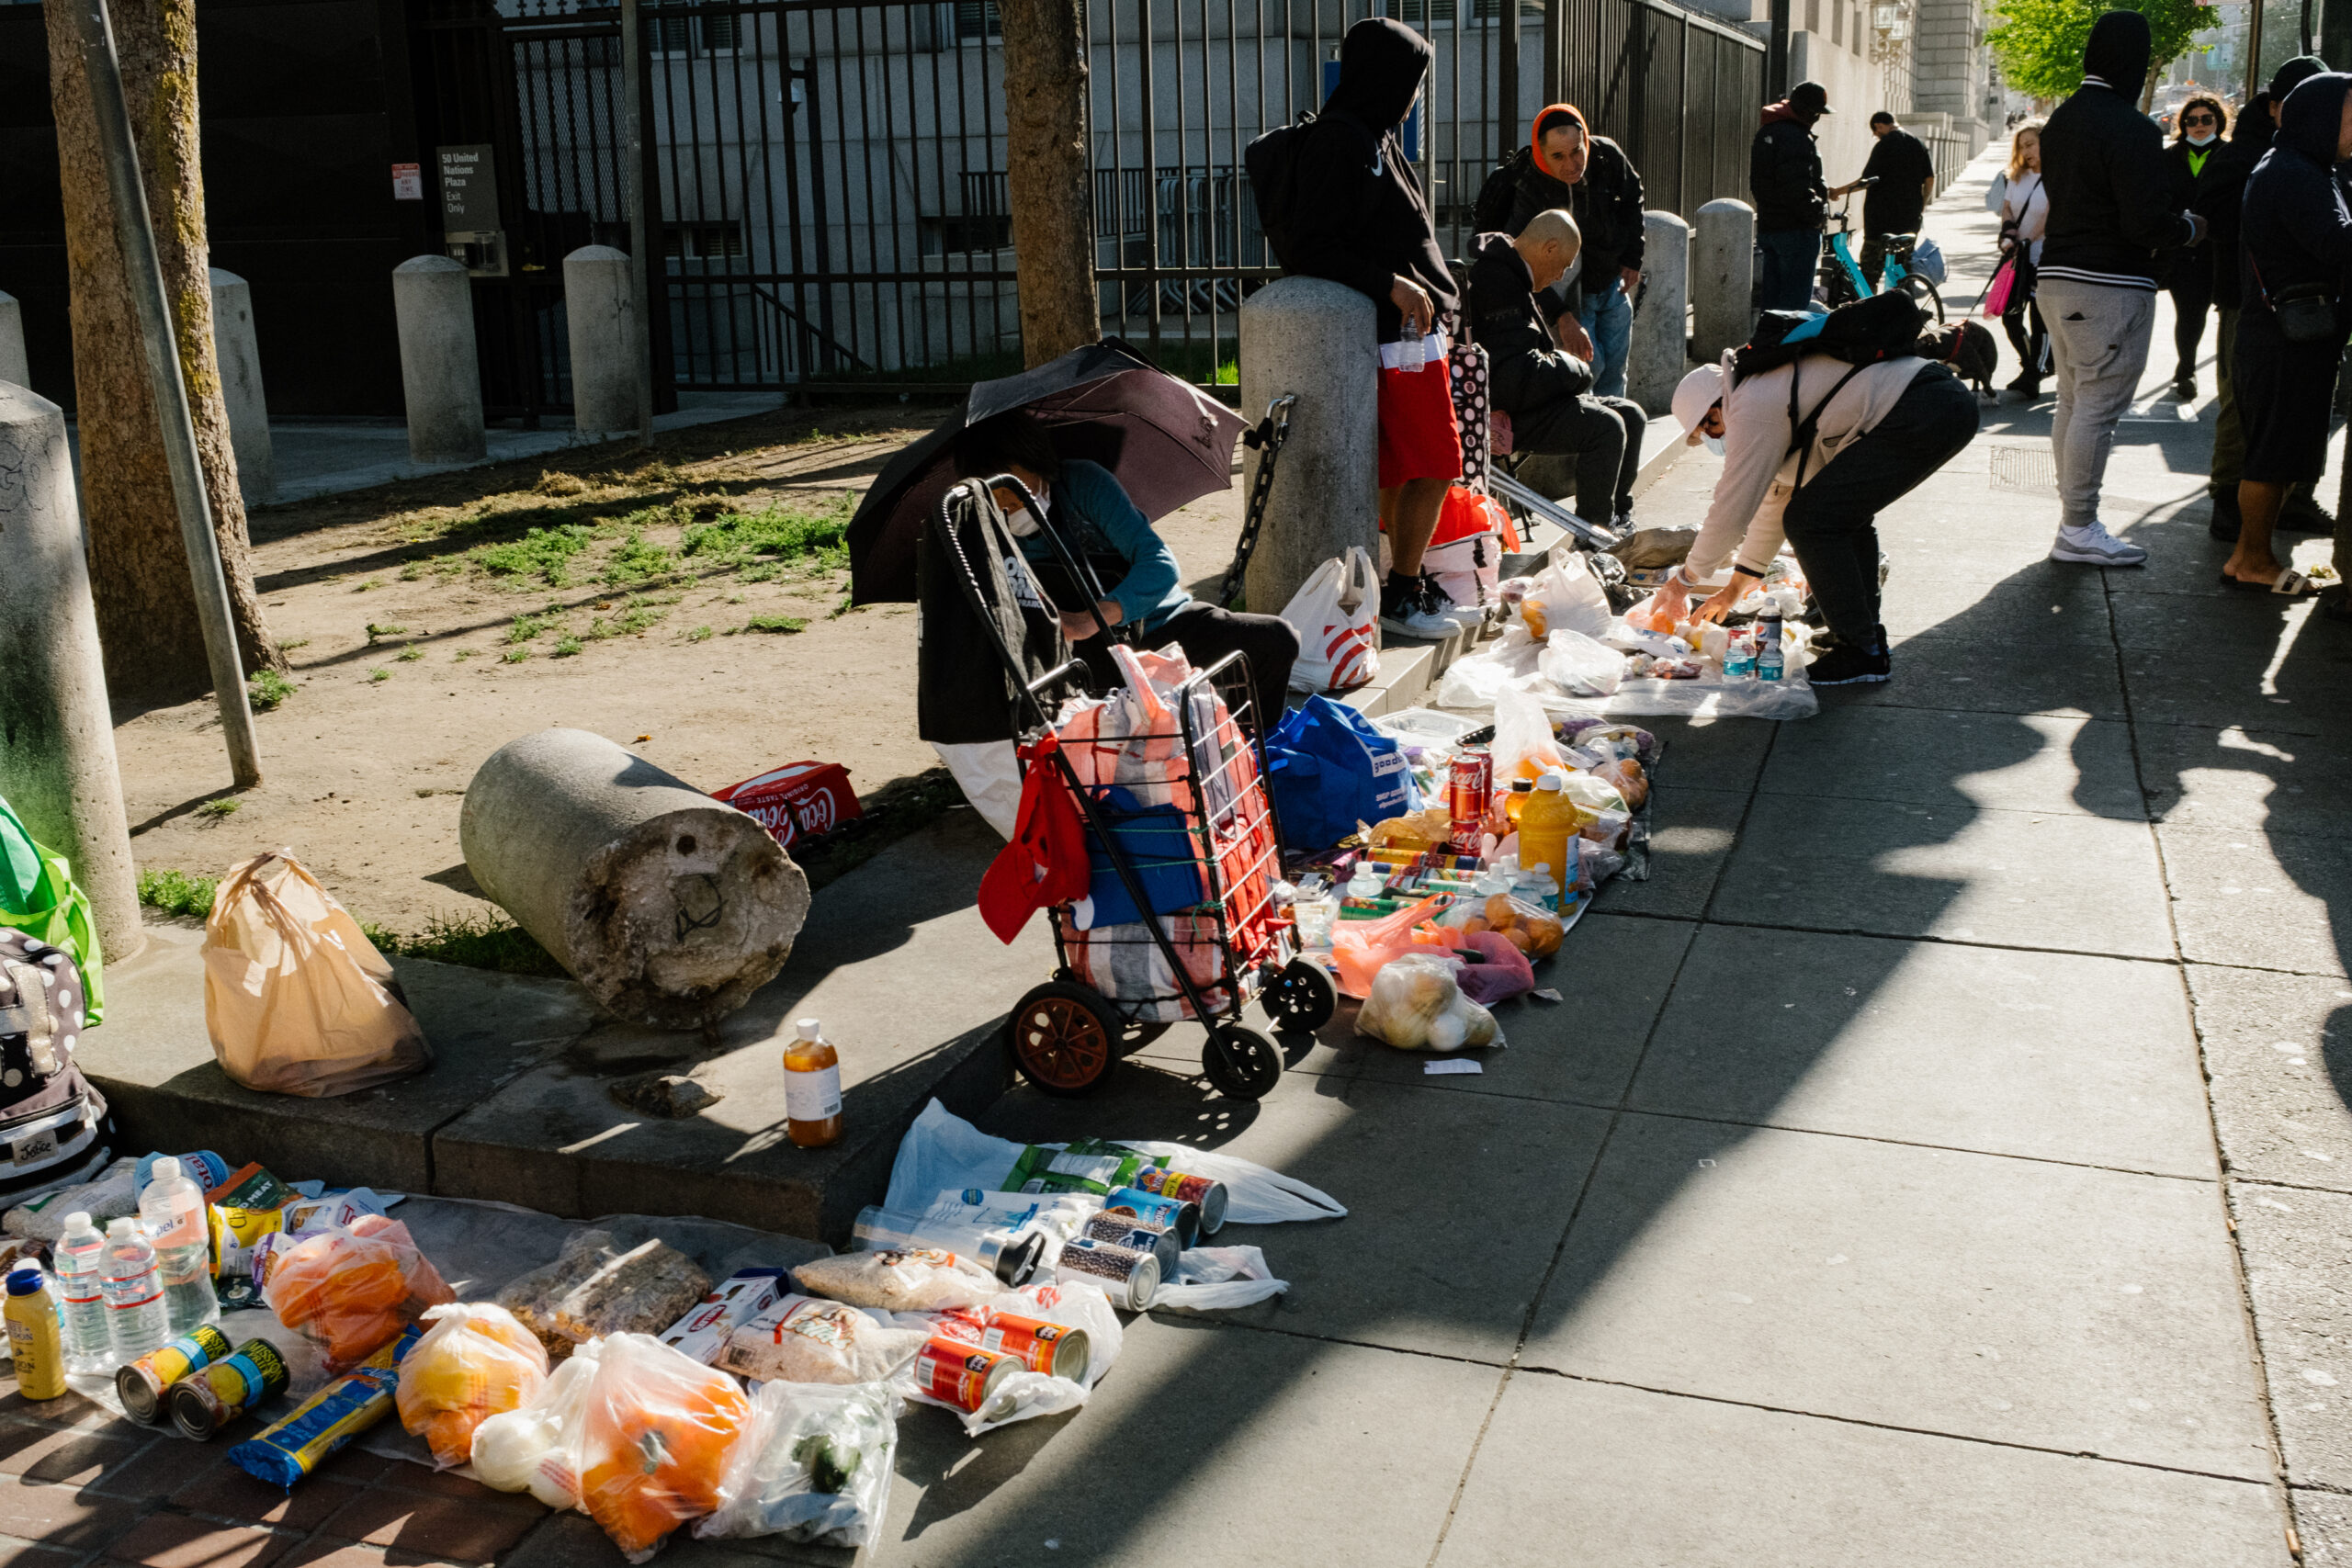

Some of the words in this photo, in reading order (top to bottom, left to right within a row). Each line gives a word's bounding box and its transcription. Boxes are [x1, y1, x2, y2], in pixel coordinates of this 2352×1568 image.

[442, 153, 451, 164] 50
[453, 152, 479, 163] United
[444, 165, 474, 175] Nations
[445, 177, 467, 186] Plaza
[447, 191, 461, 201] Exit
[447, 203, 465, 214] Only
[756, 794, 780, 804] TASTE
[20, 1141, 51, 1161] Justice
[186, 1156, 214, 1190] otal
[246, 1180, 274, 1204] MEAT
[190, 1326, 229, 1358] MISSIO
[249, 1341, 285, 1383] MISSION
